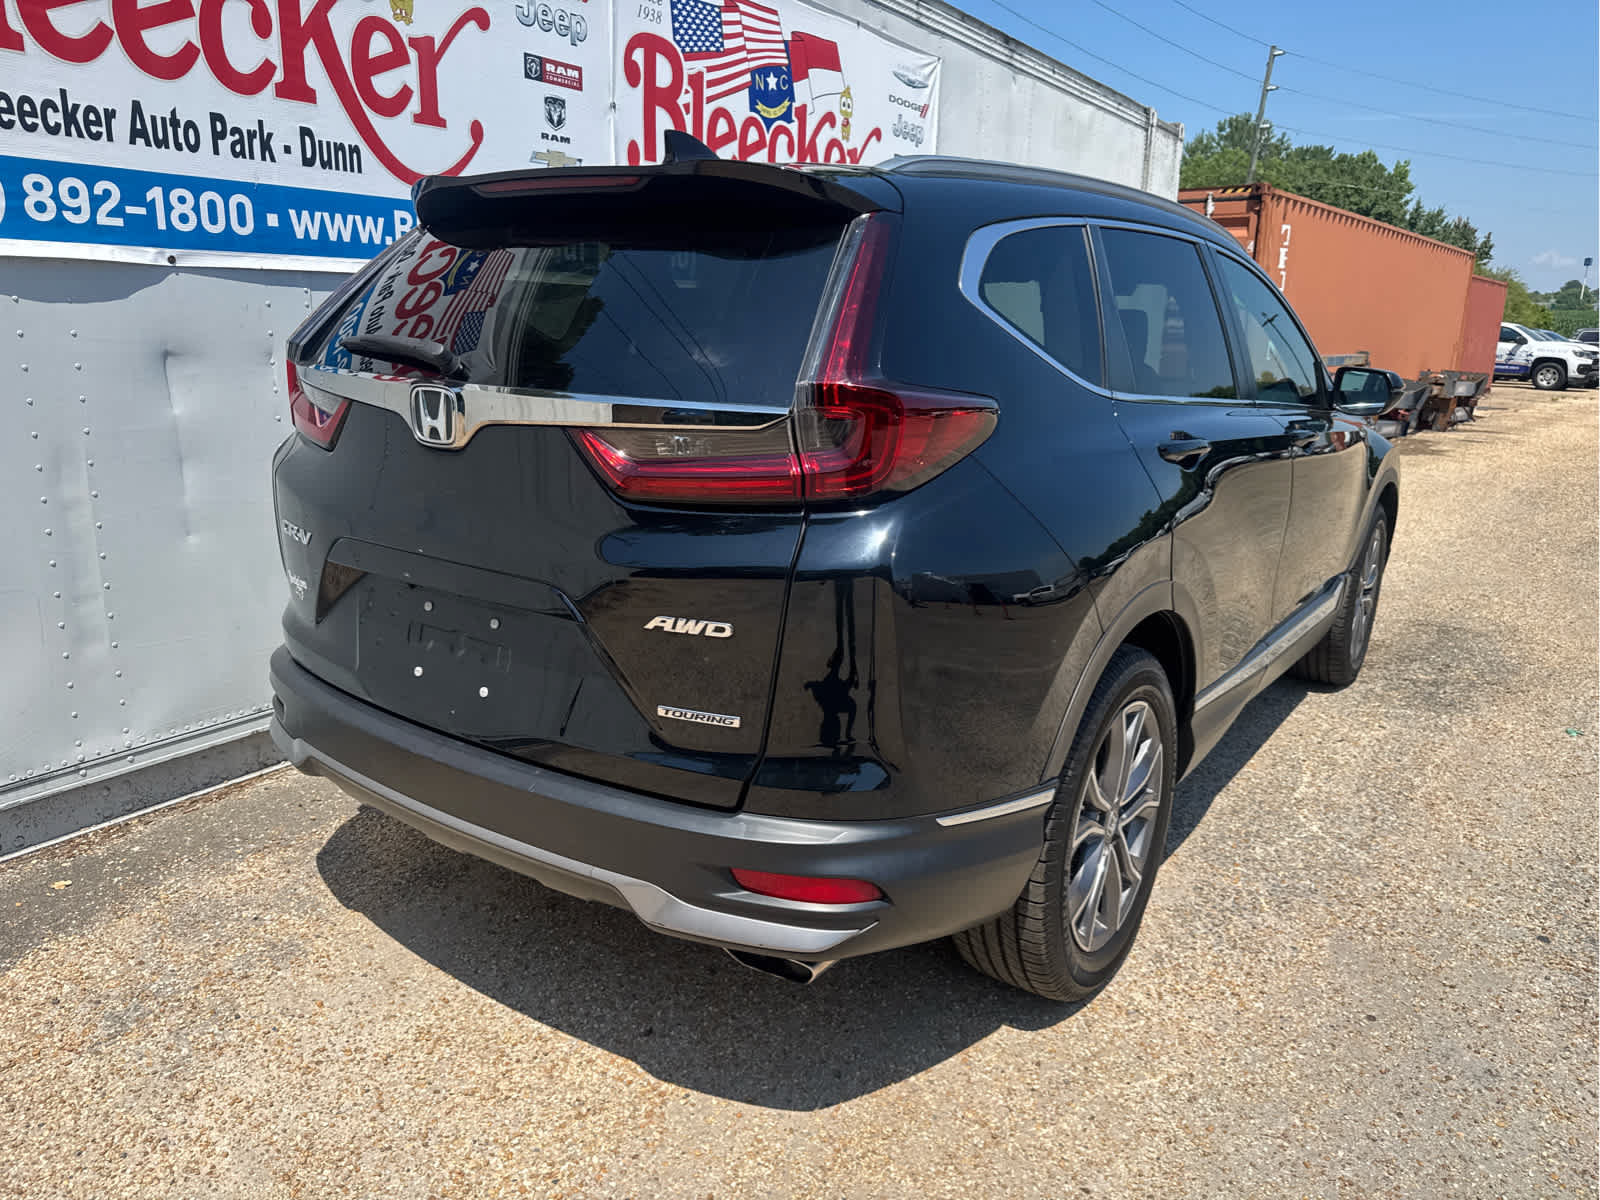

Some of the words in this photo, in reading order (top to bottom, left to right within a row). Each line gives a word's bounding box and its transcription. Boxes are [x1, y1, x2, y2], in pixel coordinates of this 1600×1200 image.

[515, 0, 588, 46] Jeep
[636, 4, 663, 24] 1938
[545, 63, 580, 79] RAM
[129, 99, 201, 153] Auto
[209, 112, 277, 162] Park
[299, 126, 363, 173] Dunn
[541, 132, 571, 144] RAM
[892, 114, 924, 148] Jeep
[22, 173, 254, 236] 892-1800
[643, 615, 734, 638] AWD
[661, 708, 736, 726] TOURING
